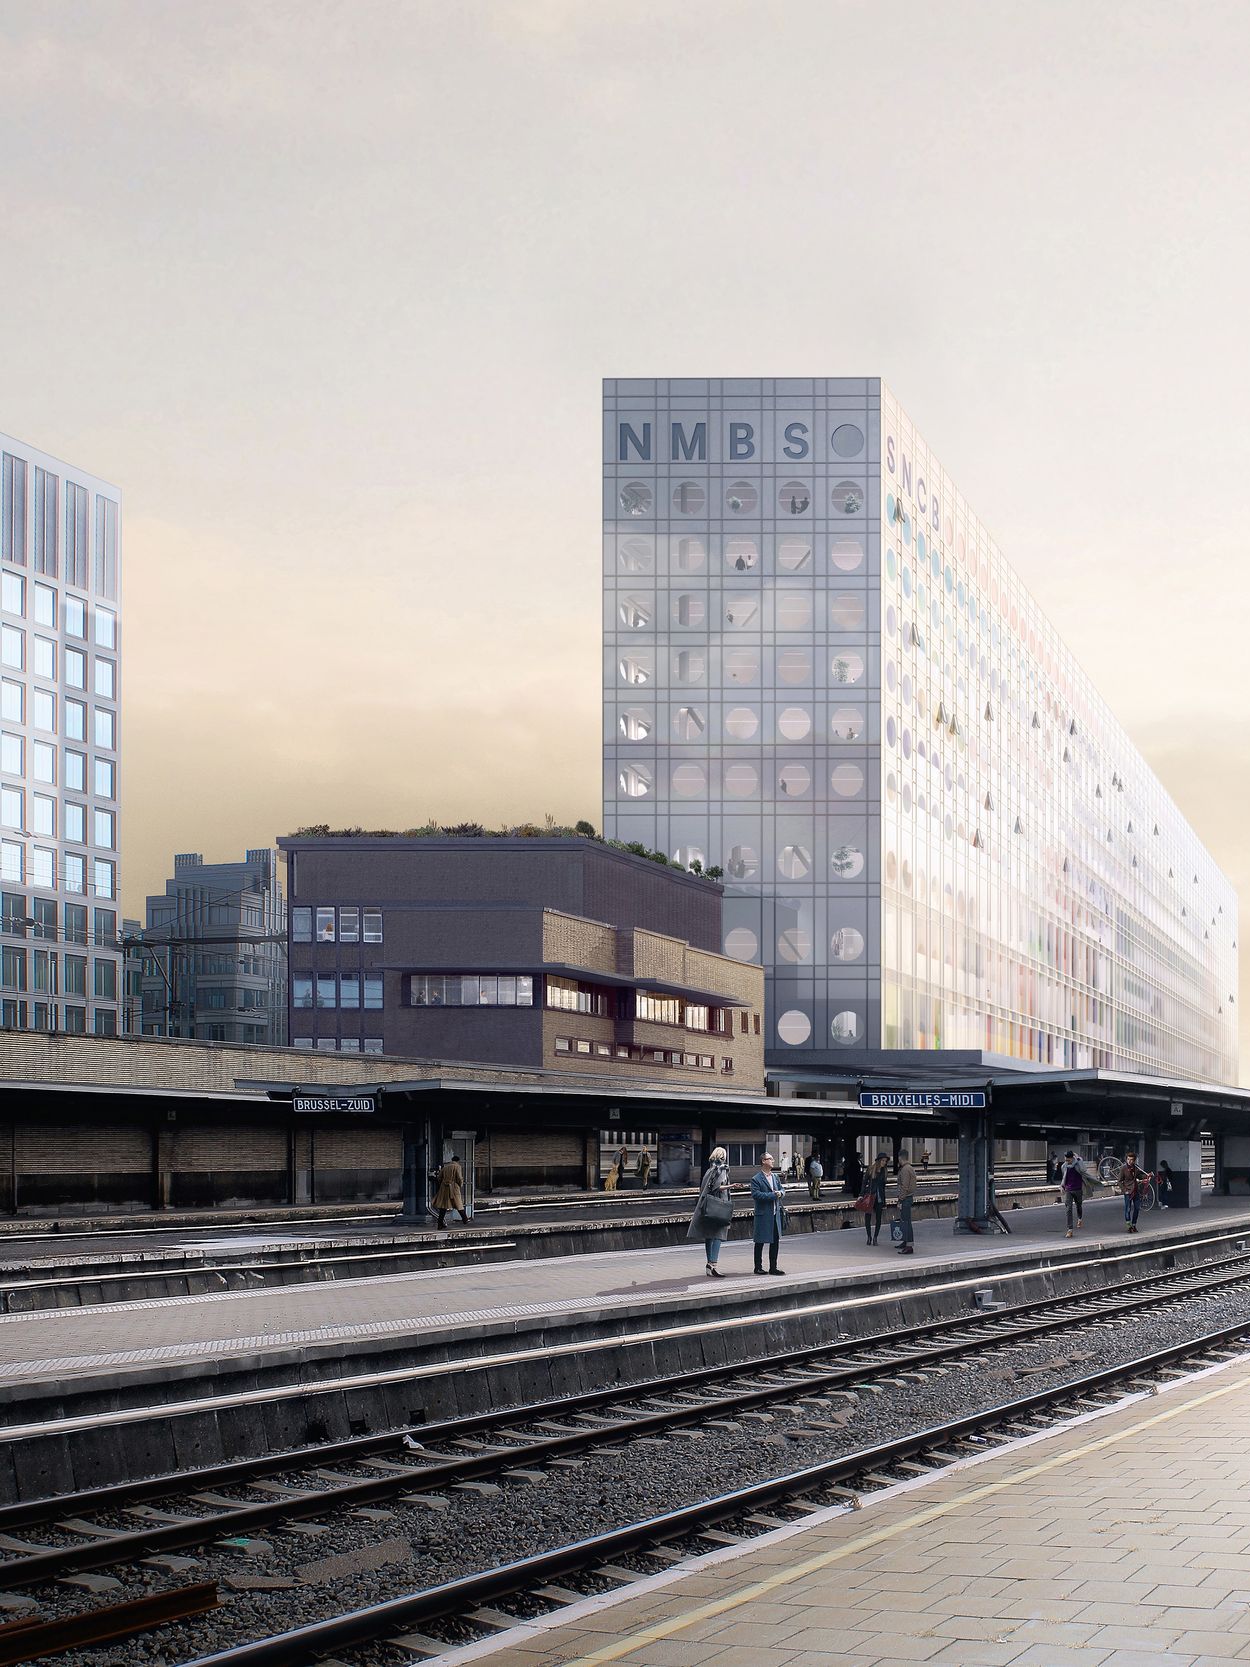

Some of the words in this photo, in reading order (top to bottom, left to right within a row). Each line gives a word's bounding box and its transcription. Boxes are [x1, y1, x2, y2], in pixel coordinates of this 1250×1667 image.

[619, 422, 810, 461] NMBS
[886, 435, 939, 532] SNCB
[297, 1100, 370, 1110] BRUSSEL-ZUID
[871, 1094, 974, 1106] BRUXELLES-MIDI
